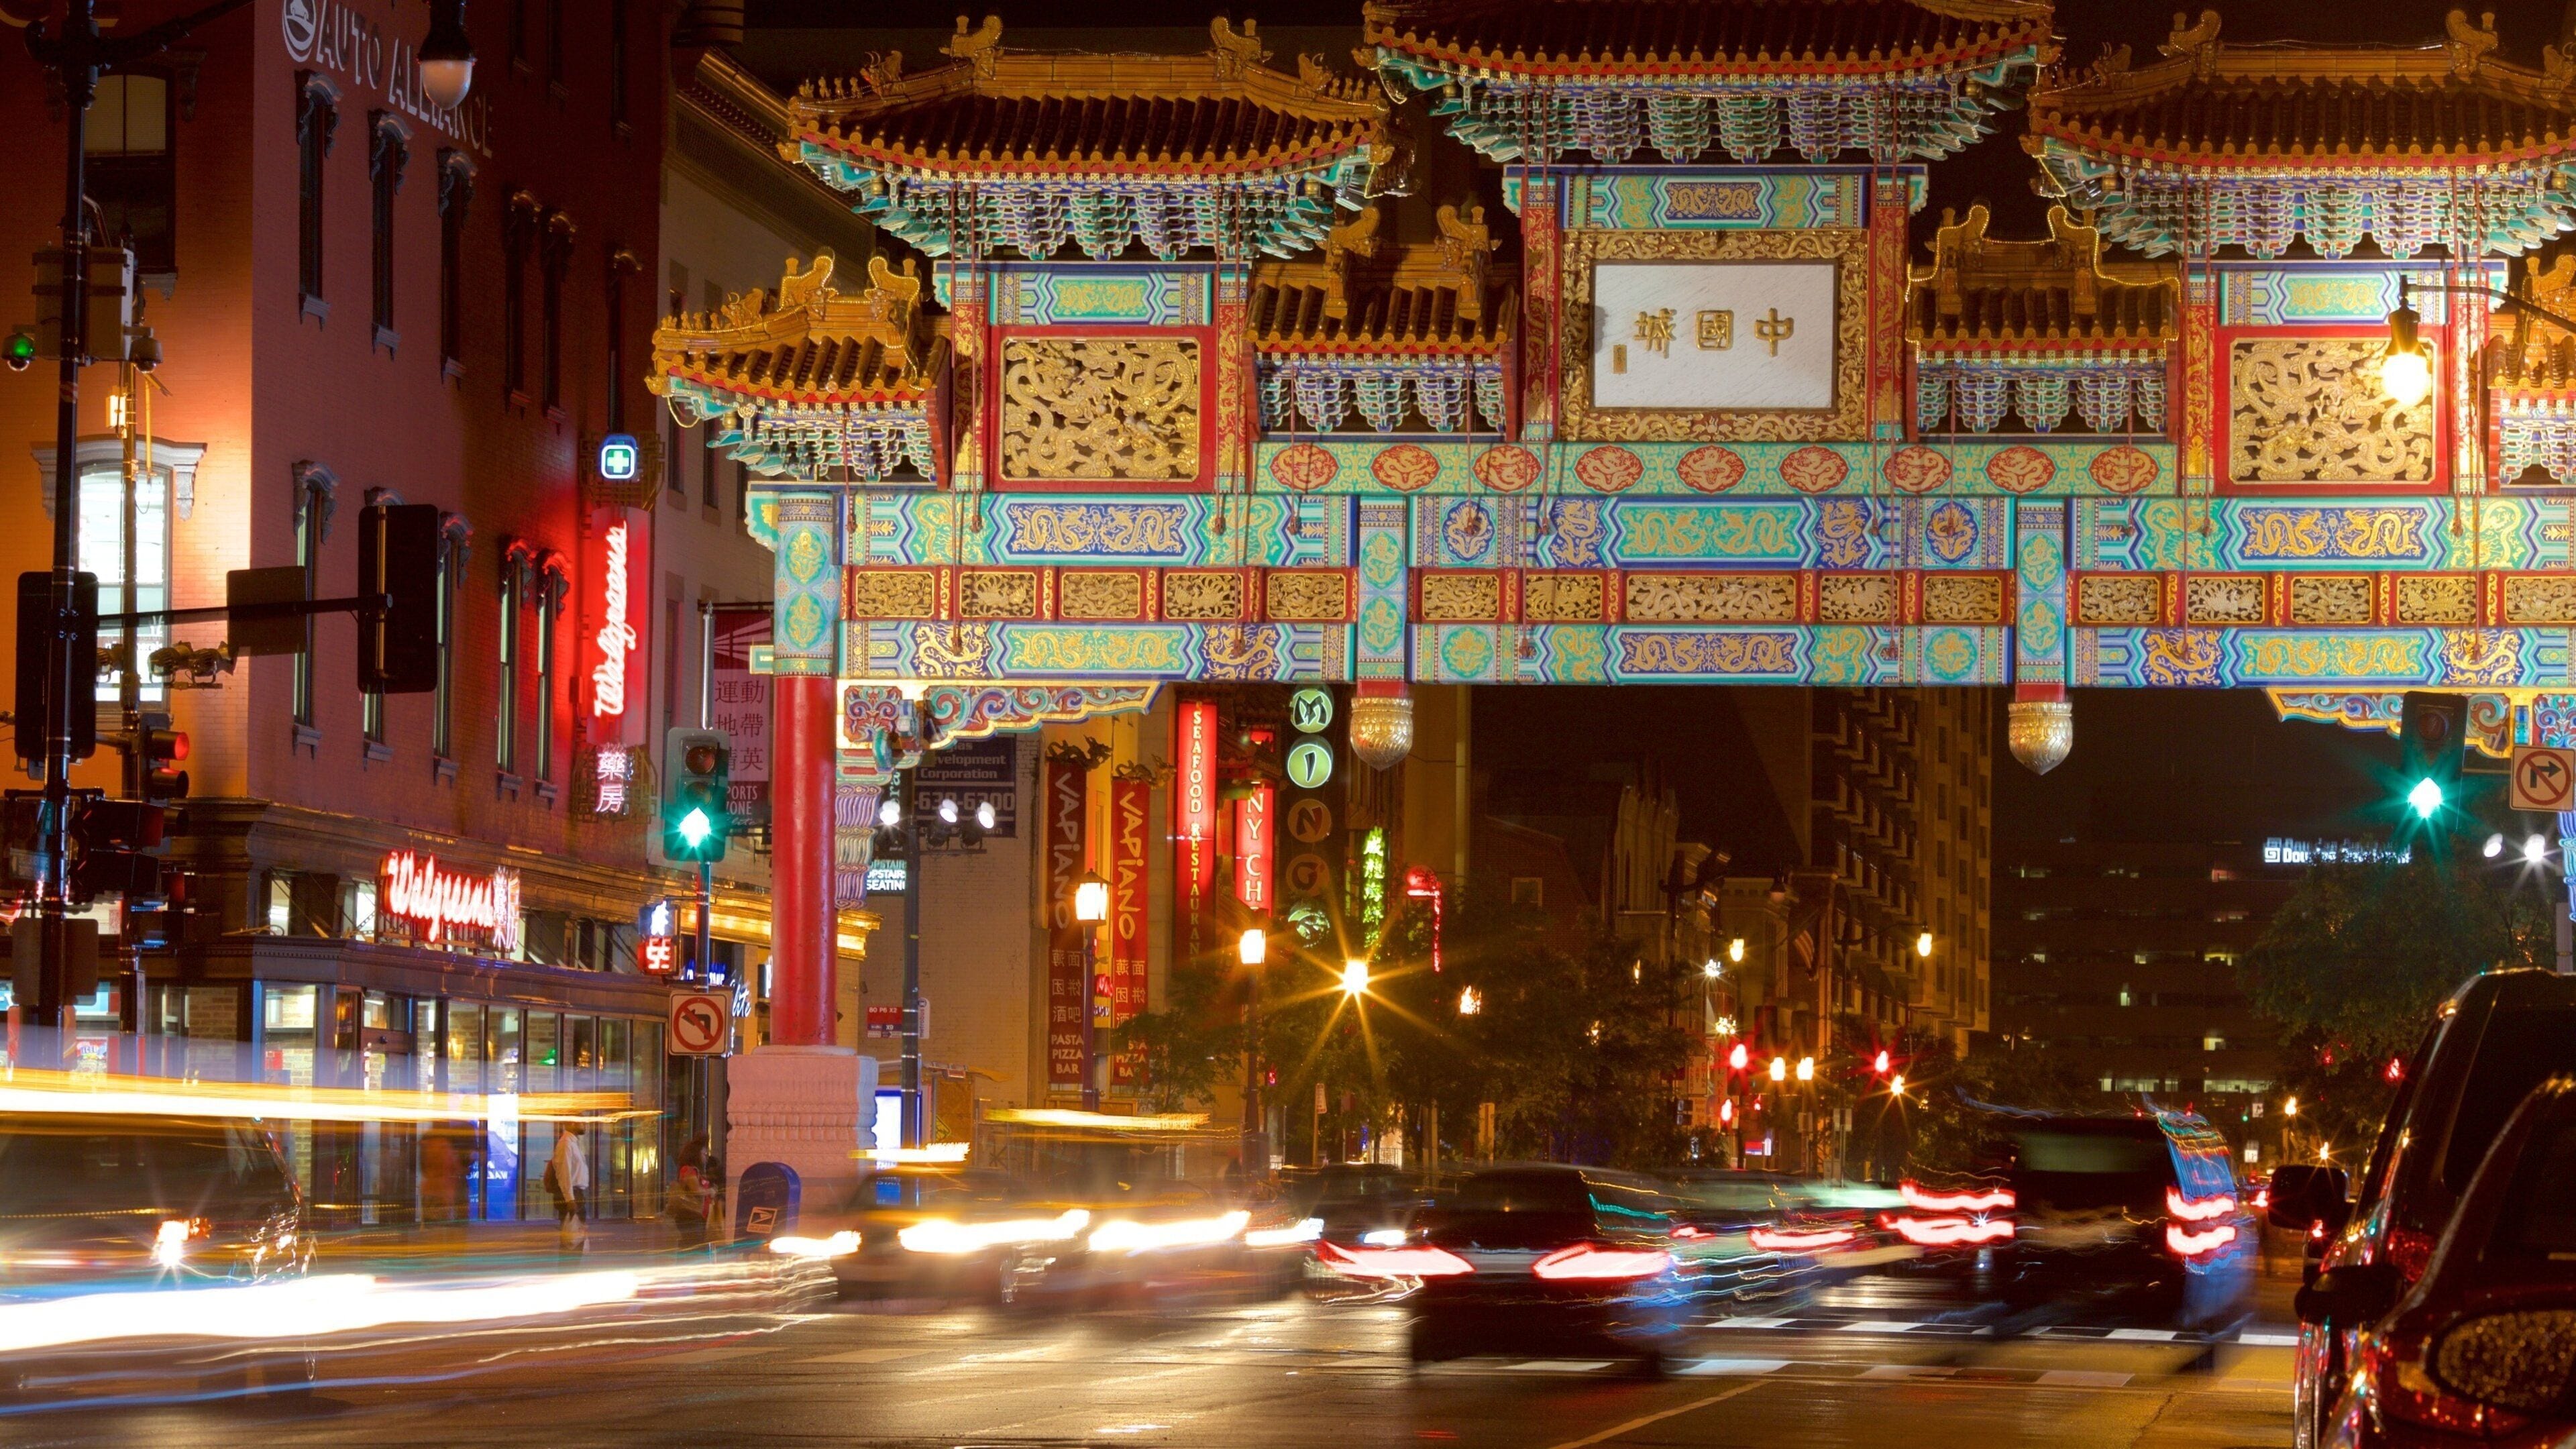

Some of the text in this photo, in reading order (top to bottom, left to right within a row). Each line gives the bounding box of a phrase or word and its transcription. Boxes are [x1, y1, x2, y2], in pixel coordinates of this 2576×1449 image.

[316, 0, 382, 89] AUTO
[592, 521, 636, 717] Walgreens
[714, 680, 765, 704] 運動
[715, 713, 763, 738] 地帶
[936, 755, 1006, 766] velopment
[1189, 711, 1203, 813] SEAFOOD
[920, 768, 998, 780] Corporation
[387, 849, 494, 942] Walgreens
[1051, 1034, 1084, 1045] PASTA
[1053, 1049, 1084, 1059] PIZZA
[1056, 1063, 1079, 1074] BAR
[1119, 1067, 1134, 1077] BA
